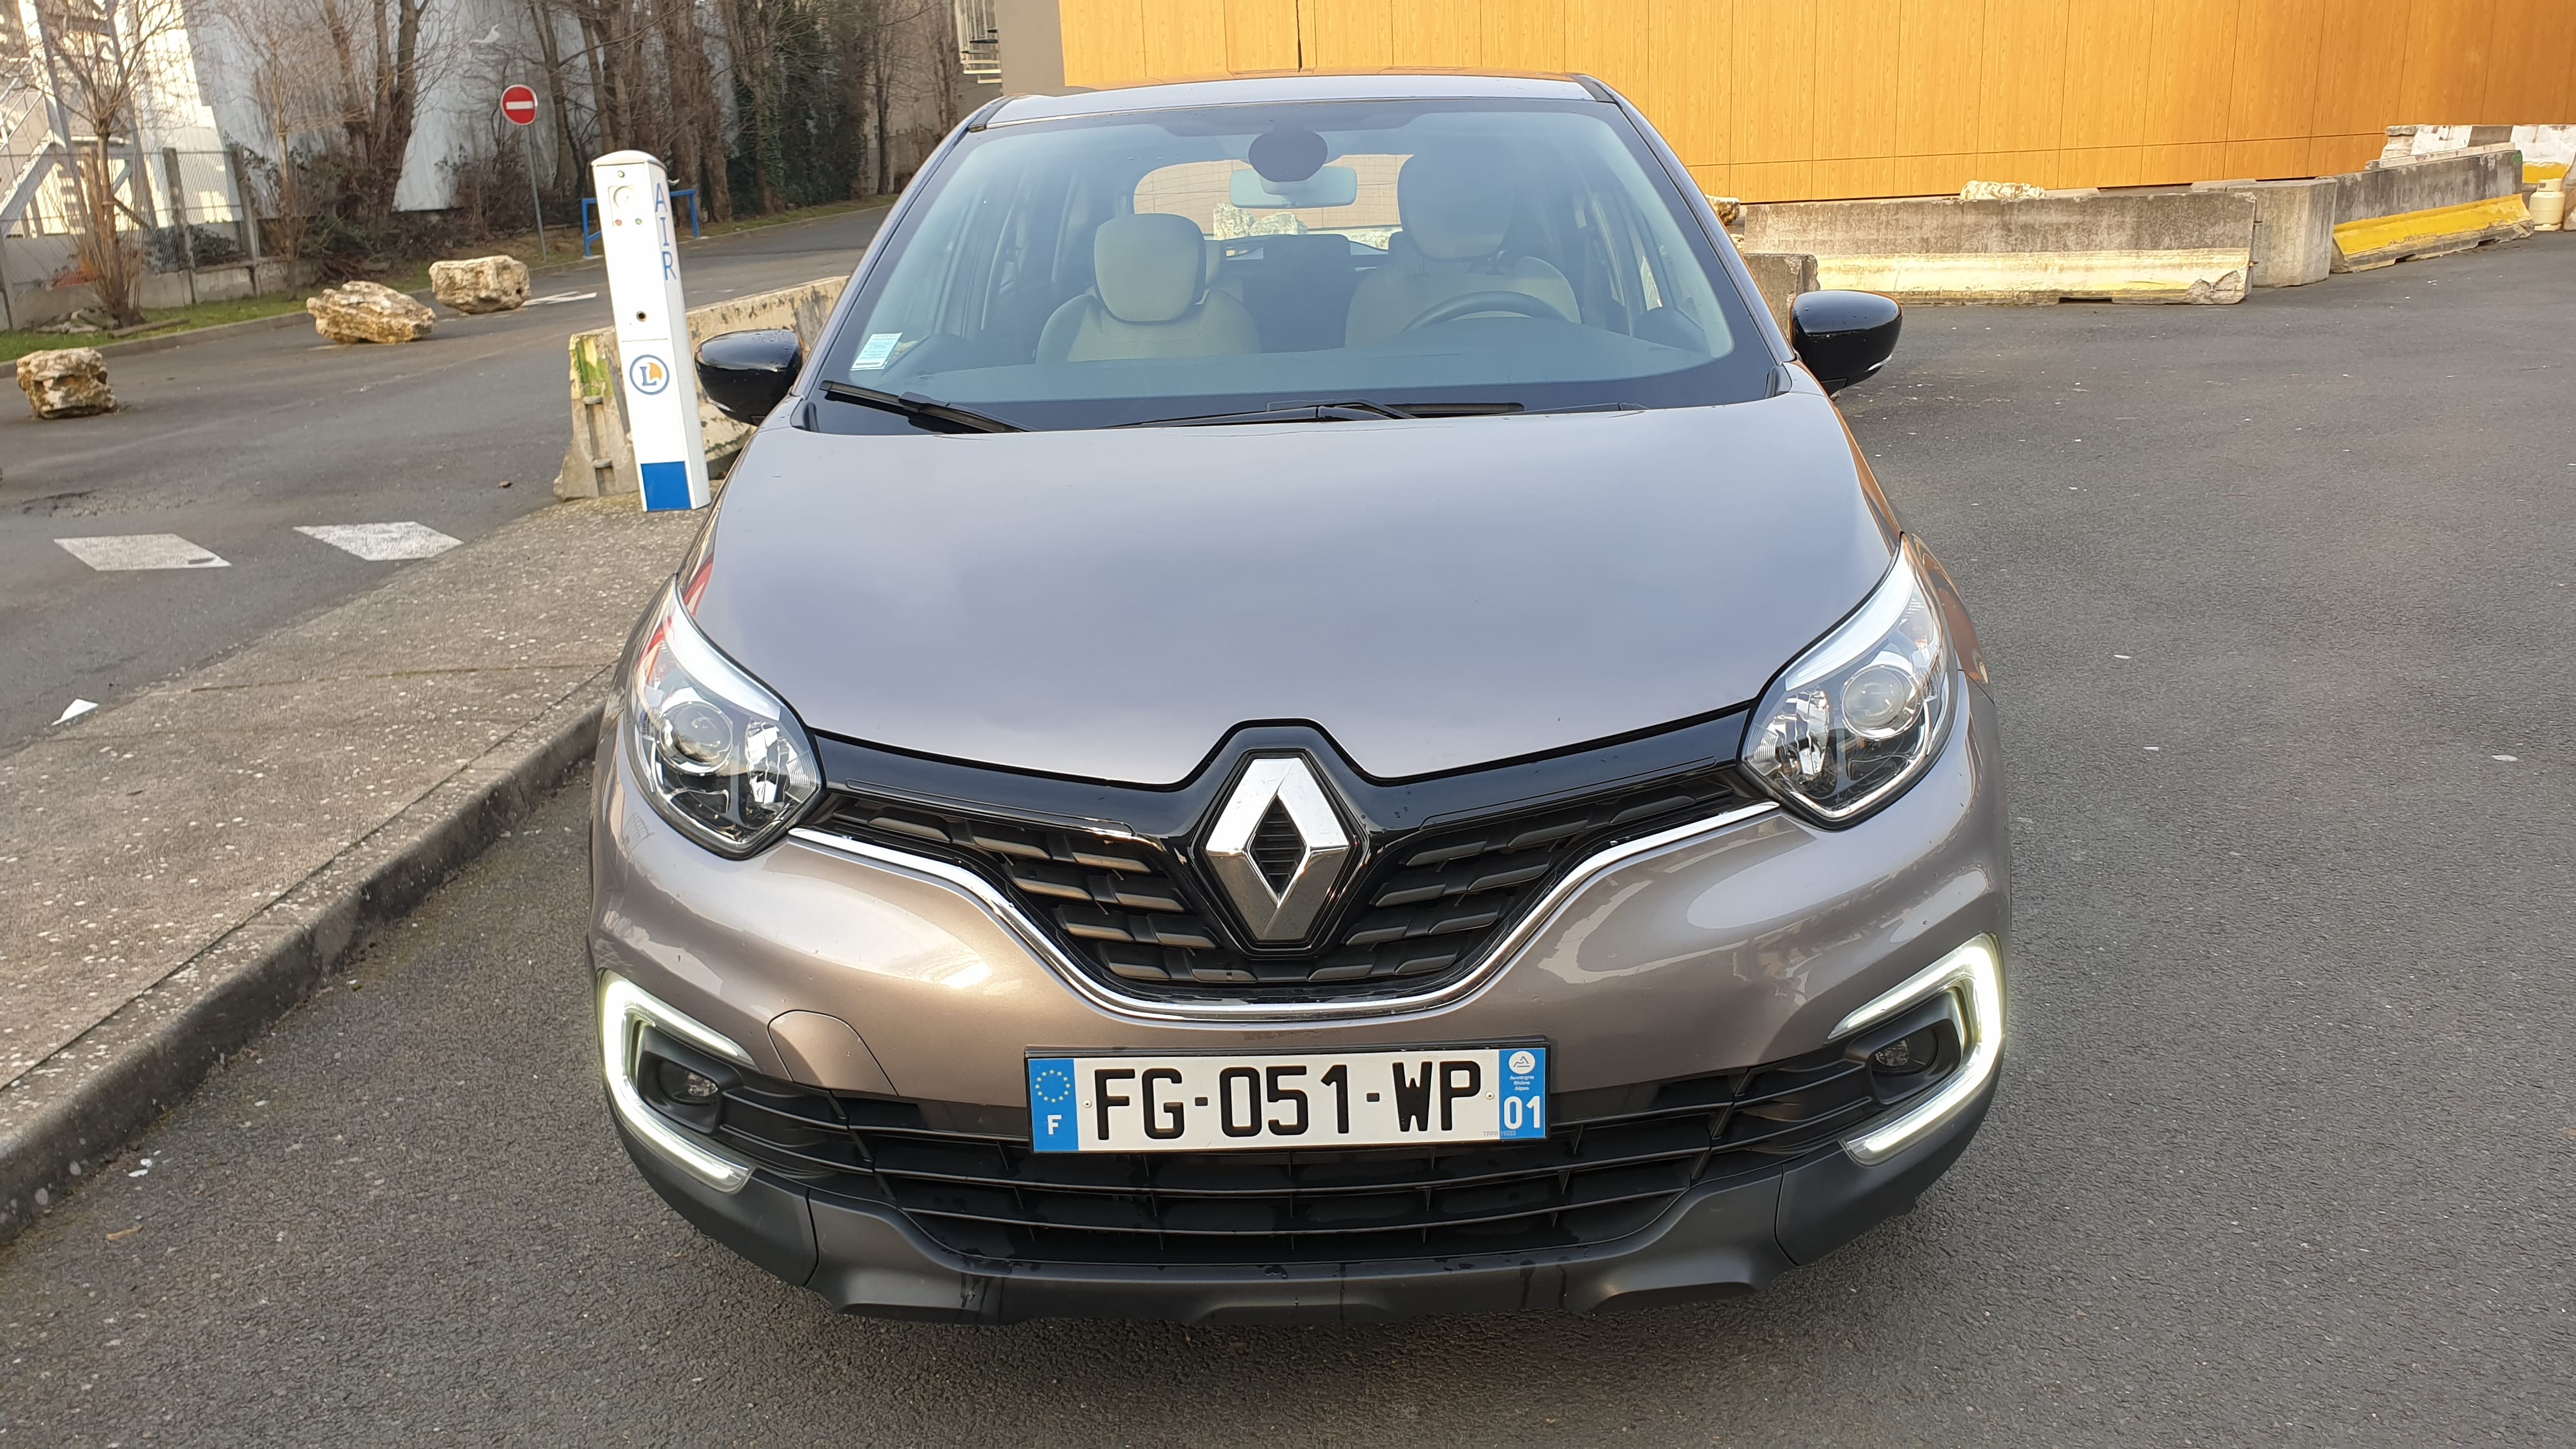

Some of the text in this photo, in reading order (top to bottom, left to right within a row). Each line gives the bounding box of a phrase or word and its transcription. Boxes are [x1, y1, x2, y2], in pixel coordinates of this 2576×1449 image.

[654, 182, 677, 280] AIR
[639, 365, 657, 387] L
[1094, 1060, 1482, 1140] FG-051-WP
[1503, 1095, 1541, 1130] 01
[1047, 1114, 1062, 1136] F
